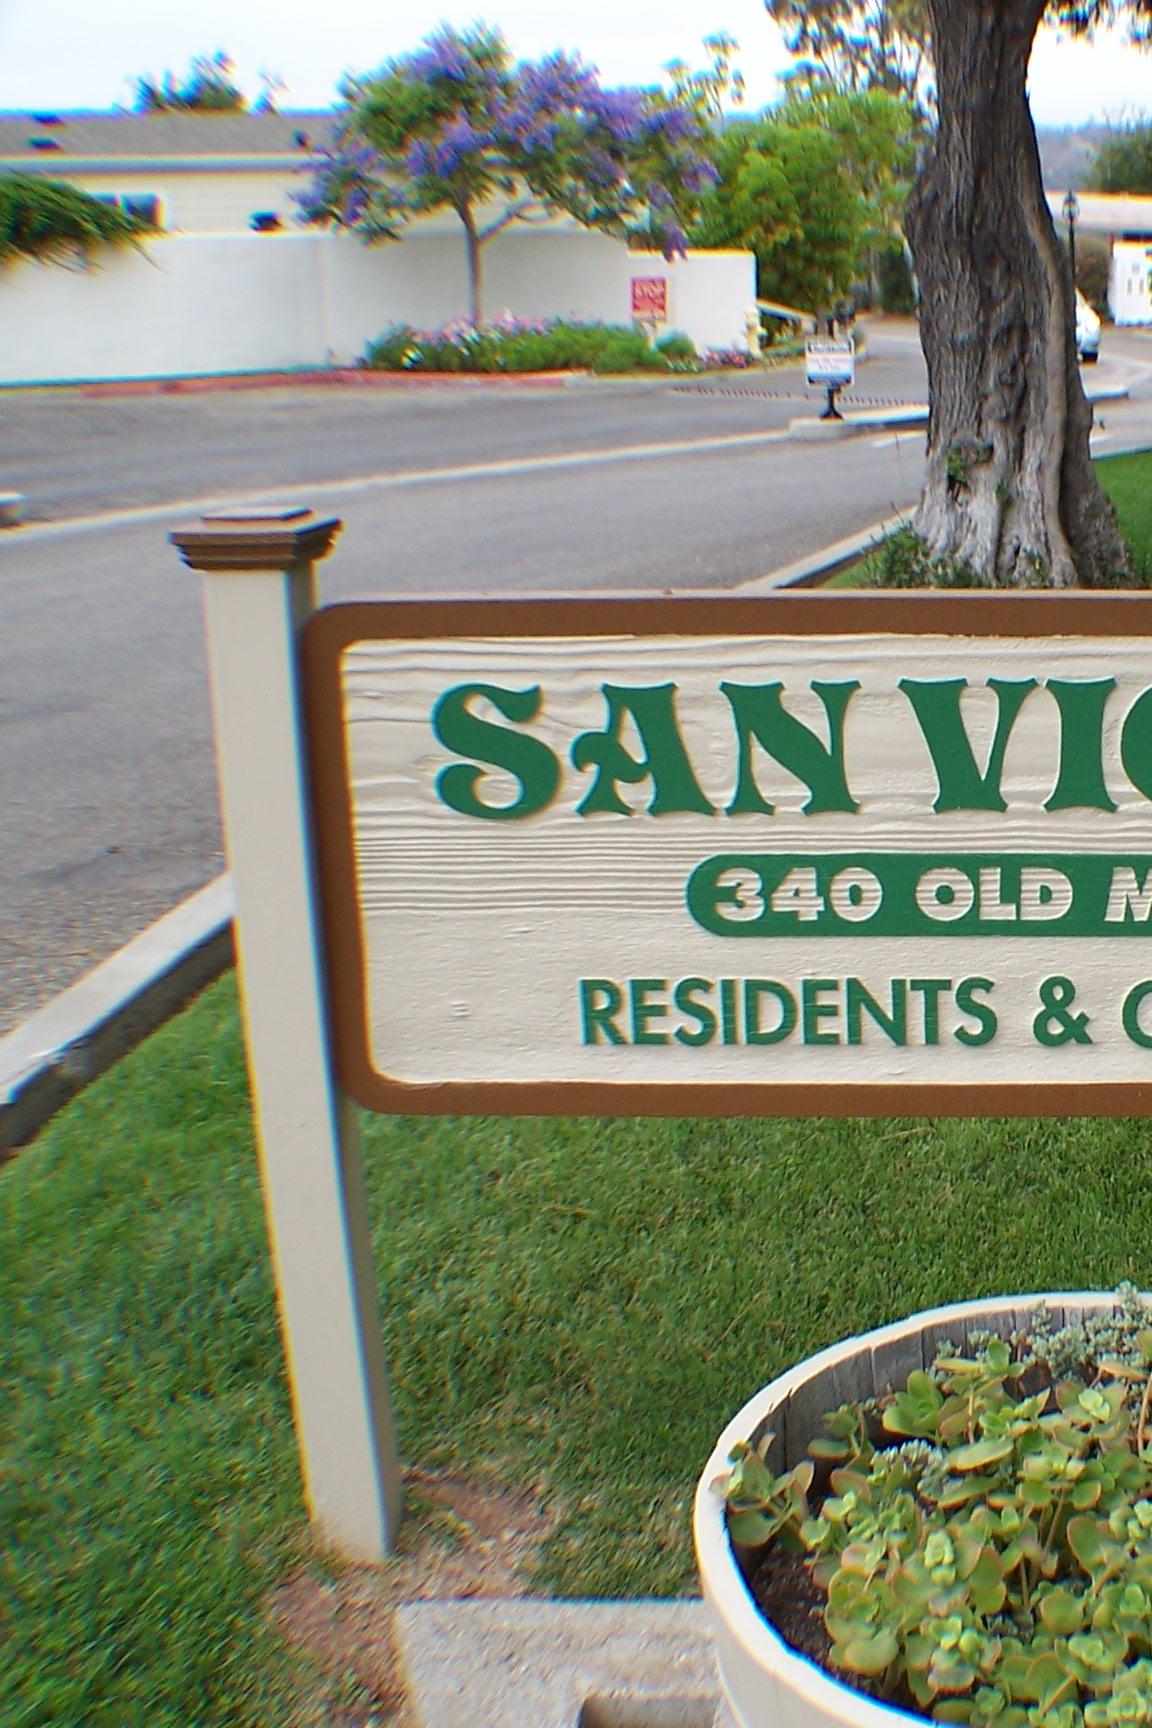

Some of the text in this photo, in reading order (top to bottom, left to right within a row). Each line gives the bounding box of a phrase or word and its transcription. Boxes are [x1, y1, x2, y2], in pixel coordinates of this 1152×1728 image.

[429, 680, 860, 820] SAN
[715, 867, 883, 922] 340
[915, 867, 1073, 921] OLD
[579, 977, 998, 1047] RESIDENTS
[1032, 977, 1093, 1047] &
